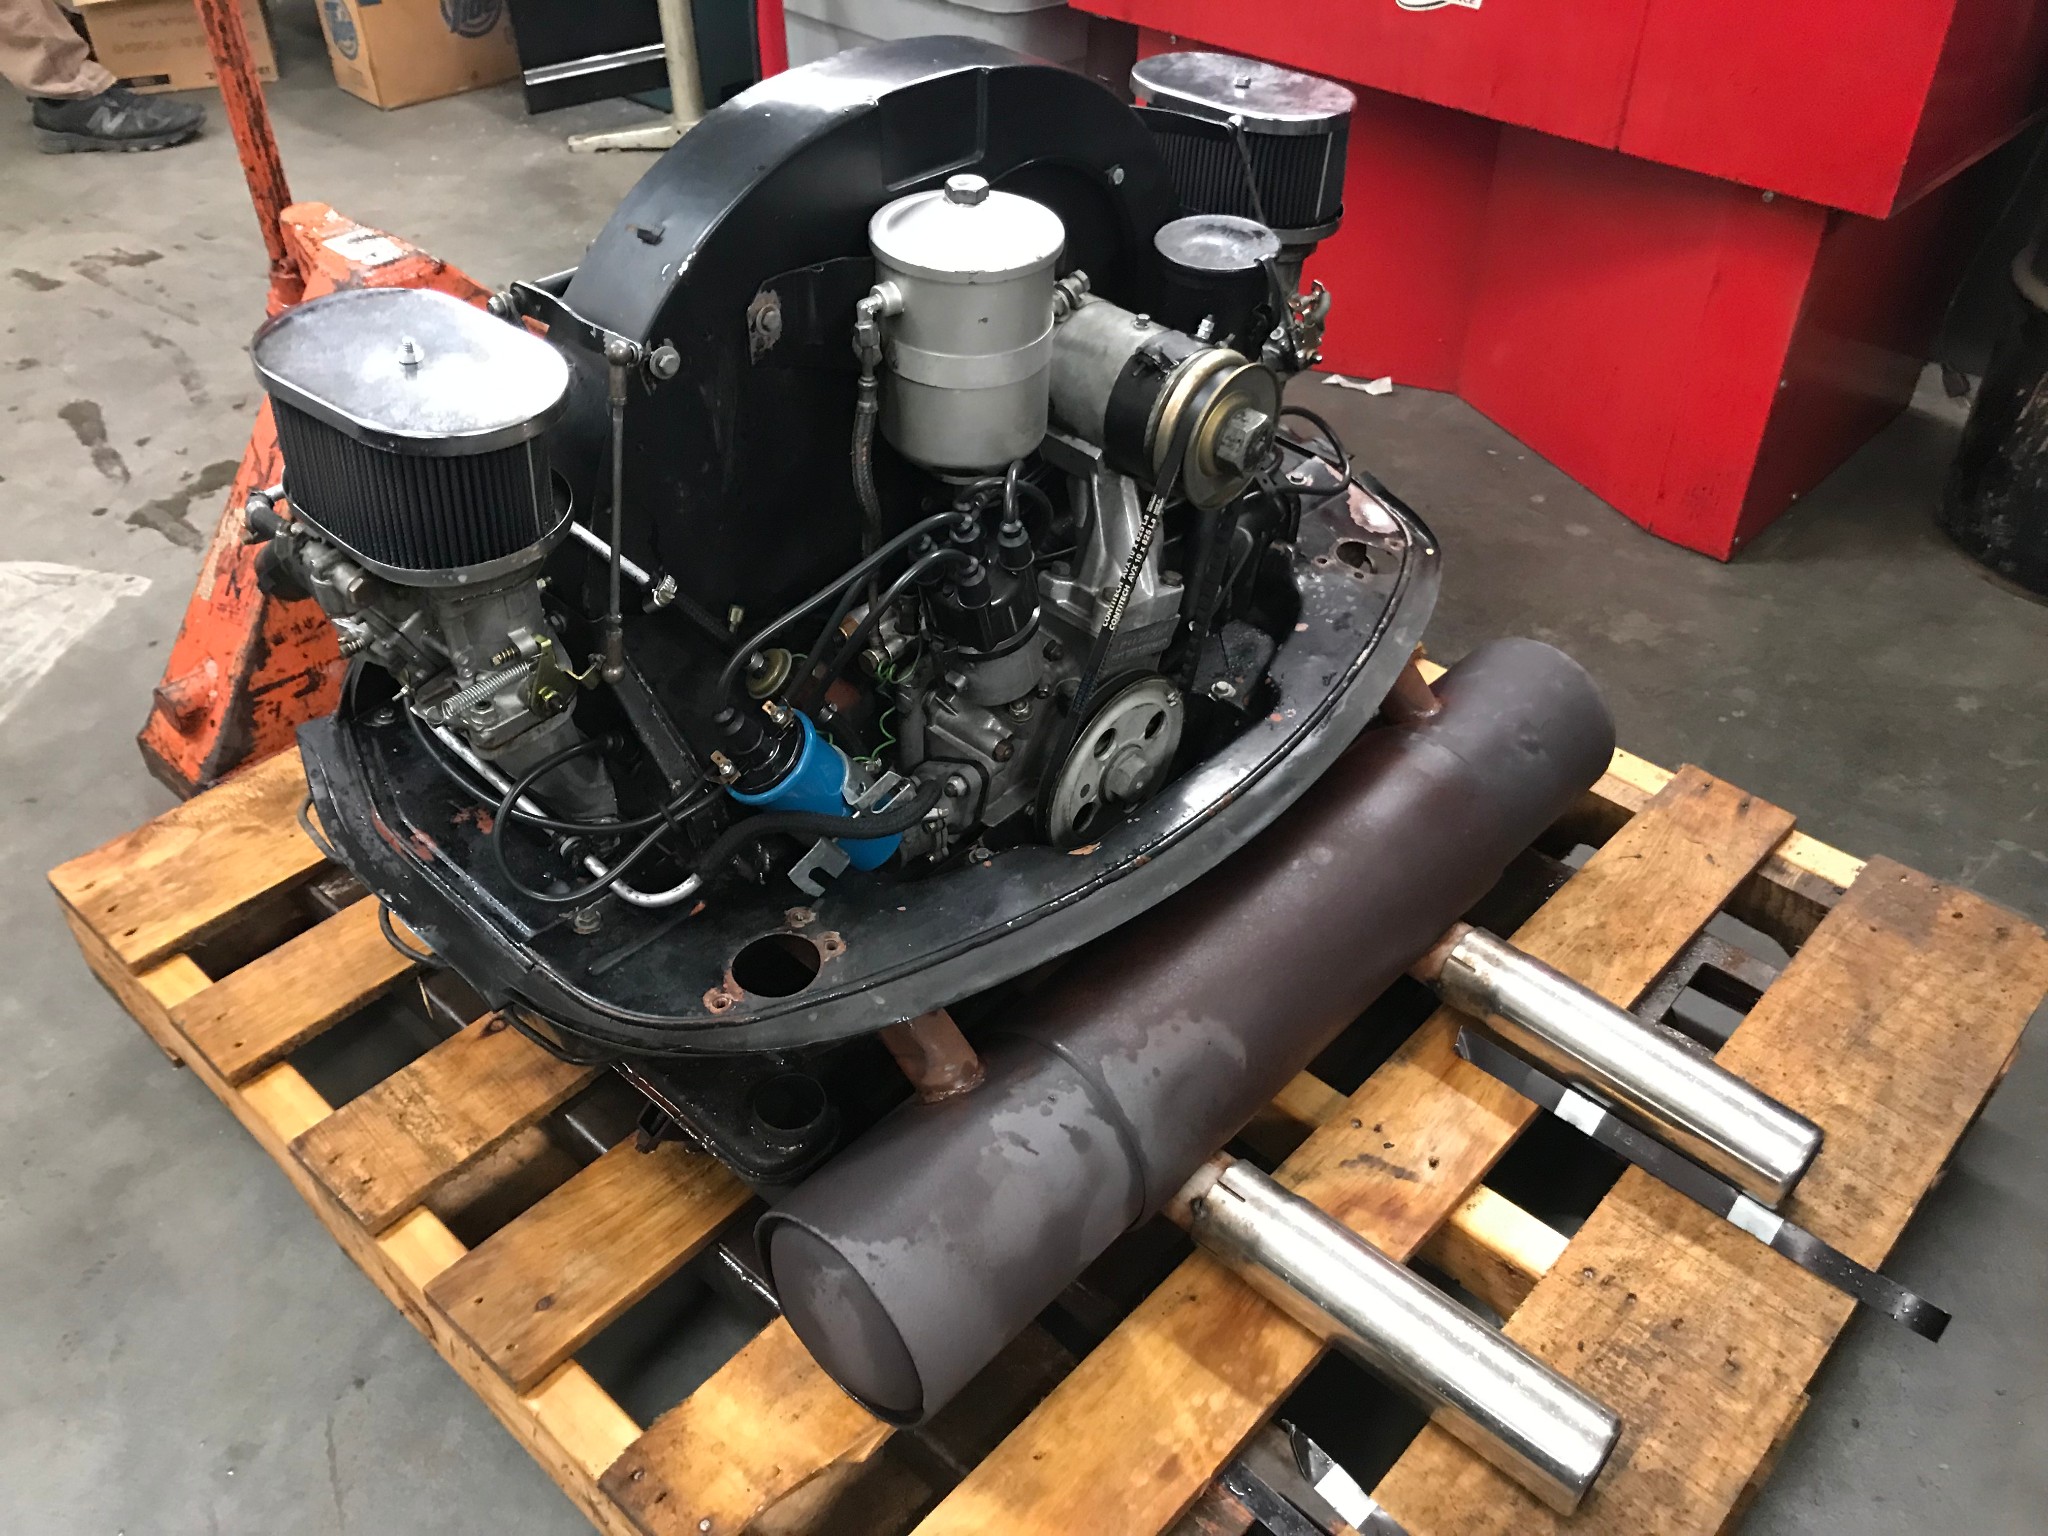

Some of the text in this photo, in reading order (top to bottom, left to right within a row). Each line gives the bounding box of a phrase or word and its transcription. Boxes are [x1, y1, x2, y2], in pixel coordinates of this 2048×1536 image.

[1109, 584, 1131, 631] CONTITECH
[1128, 564, 1138, 583] AVX
[1134, 553, 1142, 563] 10
[1141, 529, 1152, 546] 825
[1147, 518, 1156, 529] La
